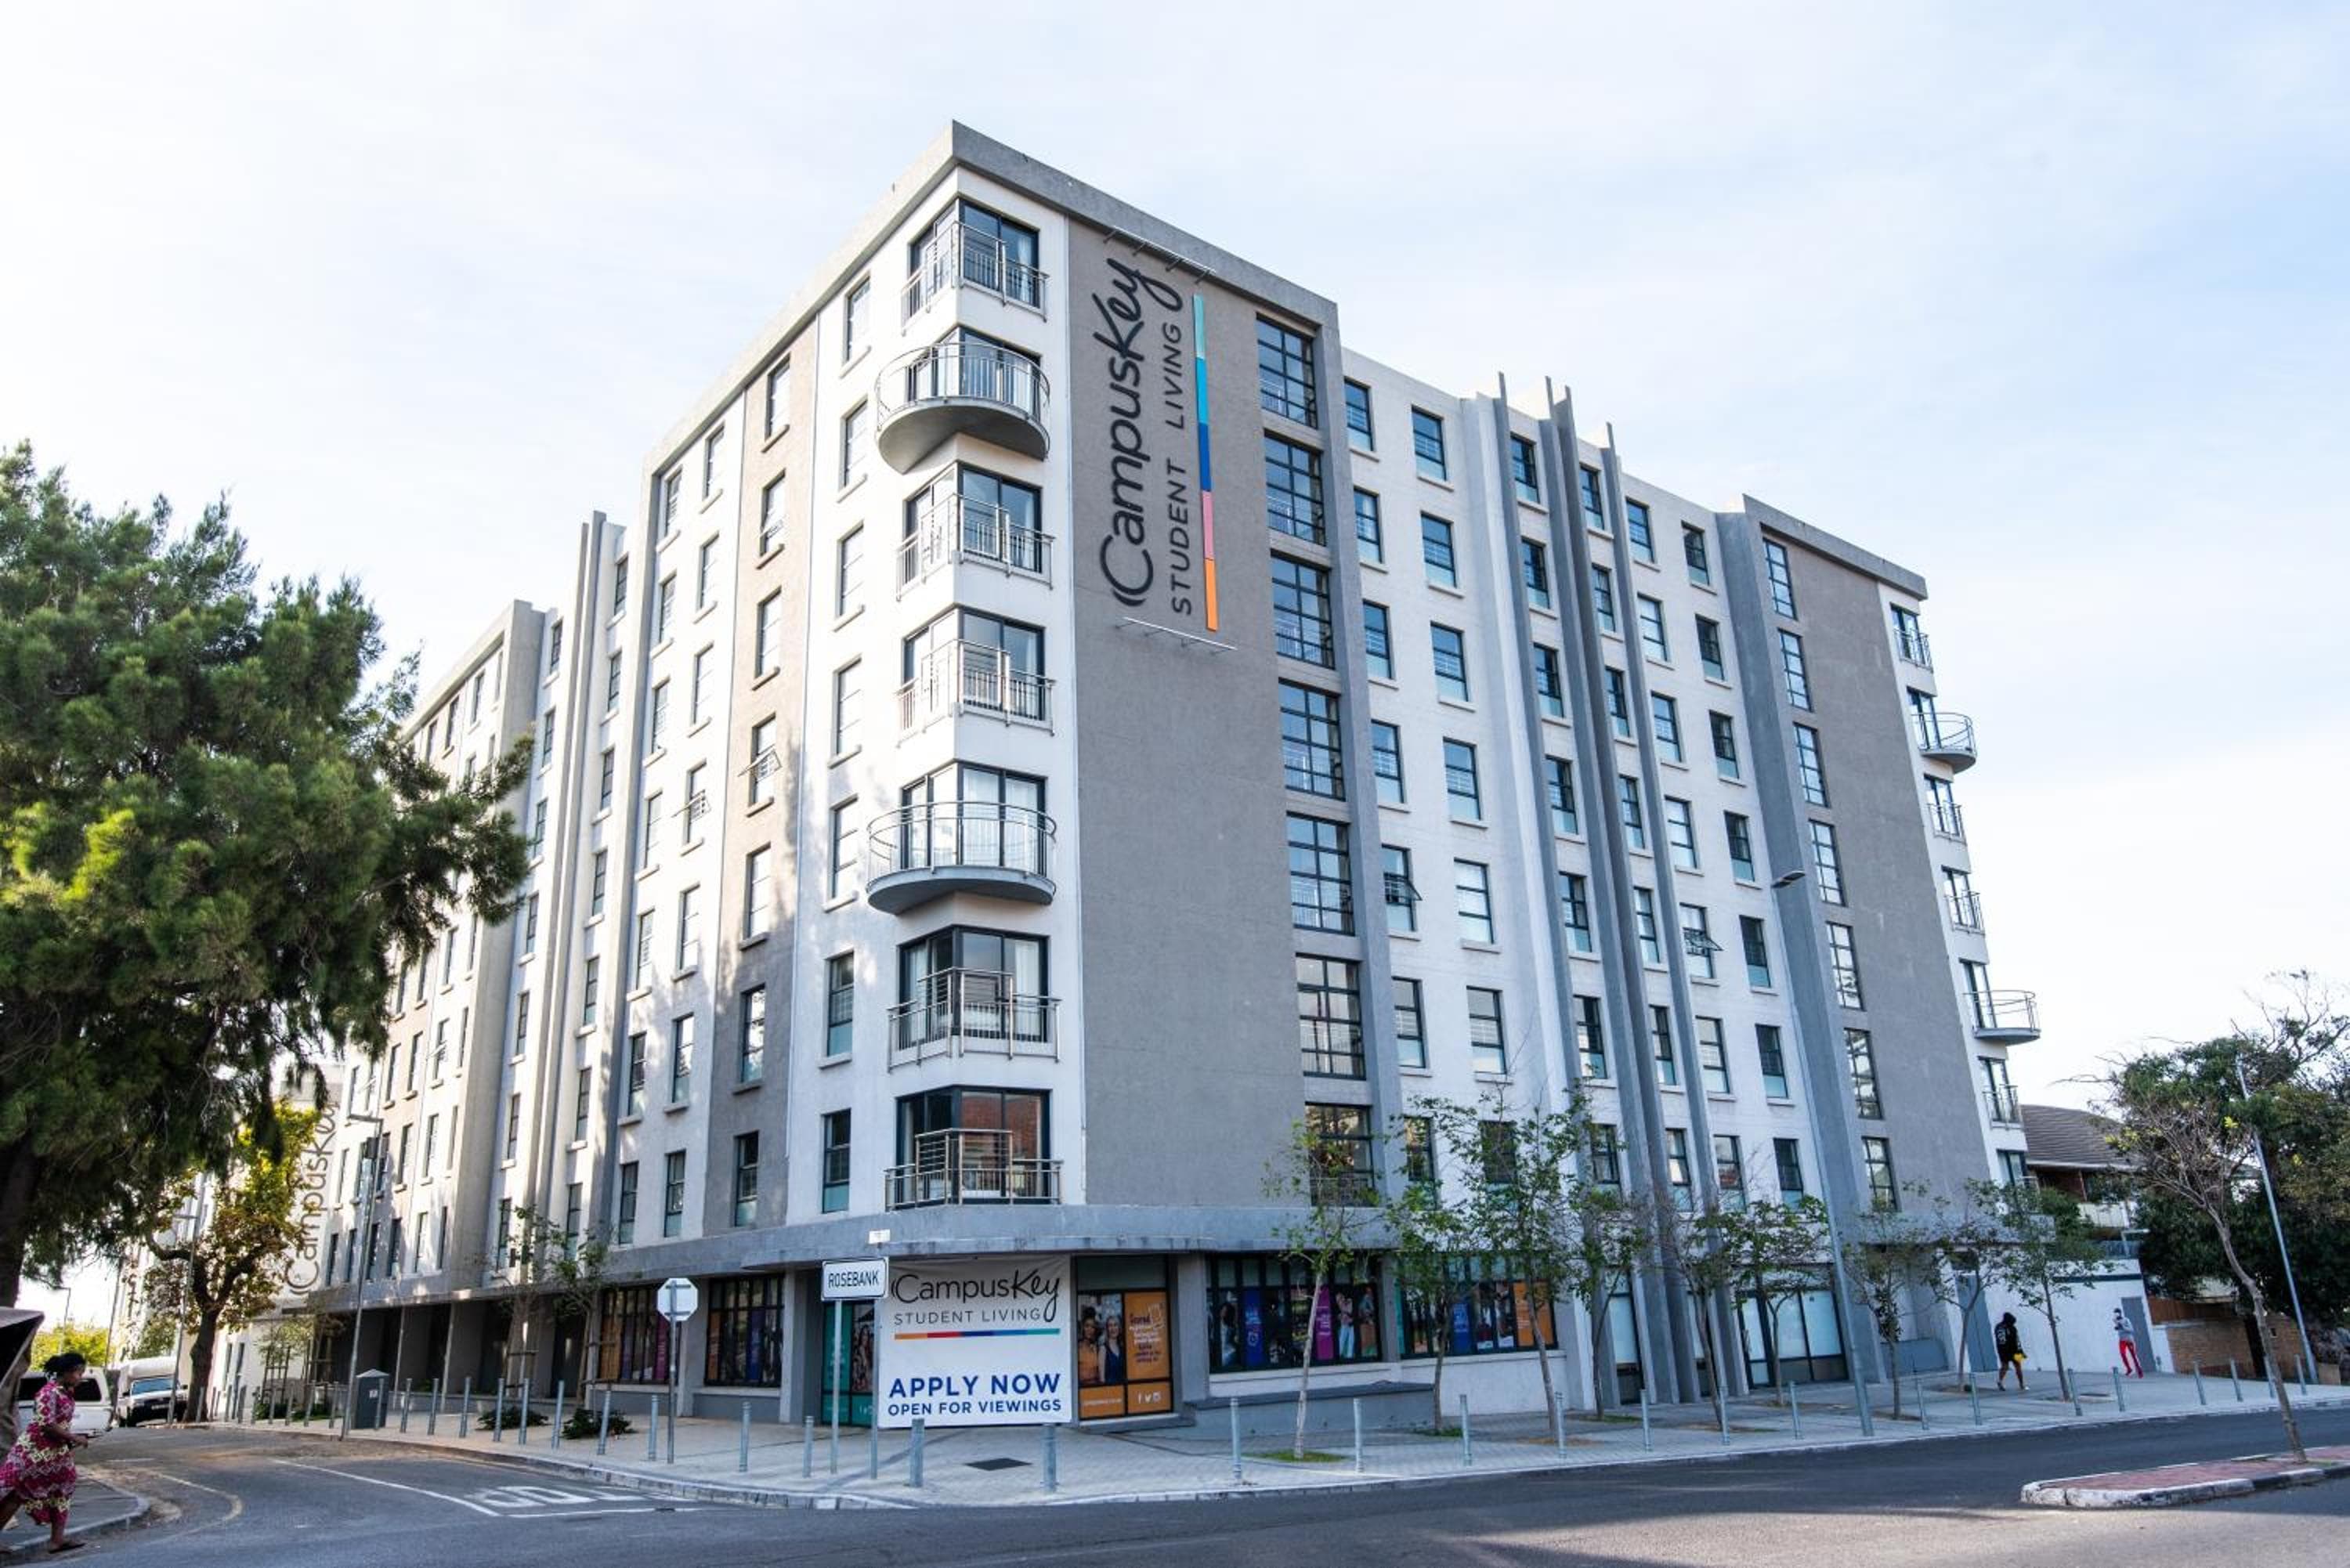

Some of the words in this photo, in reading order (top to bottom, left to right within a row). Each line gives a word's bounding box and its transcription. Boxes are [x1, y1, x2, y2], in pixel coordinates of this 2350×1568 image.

[1164, 322, 1184, 430] LIVING
[1092, 257, 1184, 608] CampusKey
[1165, 457, 1192, 616] STUDENT
[827, 1269, 880, 1289] ROSEBANK
[891, 1268, 1061, 1323] CampusKey
[894, 1310, 974, 1325] STUDENT
[982, 1308, 1041, 1322] LIVING
[888, 1375, 978, 1398] APPLY
[991, 1373, 1061, 1395] NOW
[888, 1403, 932, 1416] OPEN
[939, 1401, 972, 1414] FOR
[978, 1399, 1061, 1414] VIEWINGS
